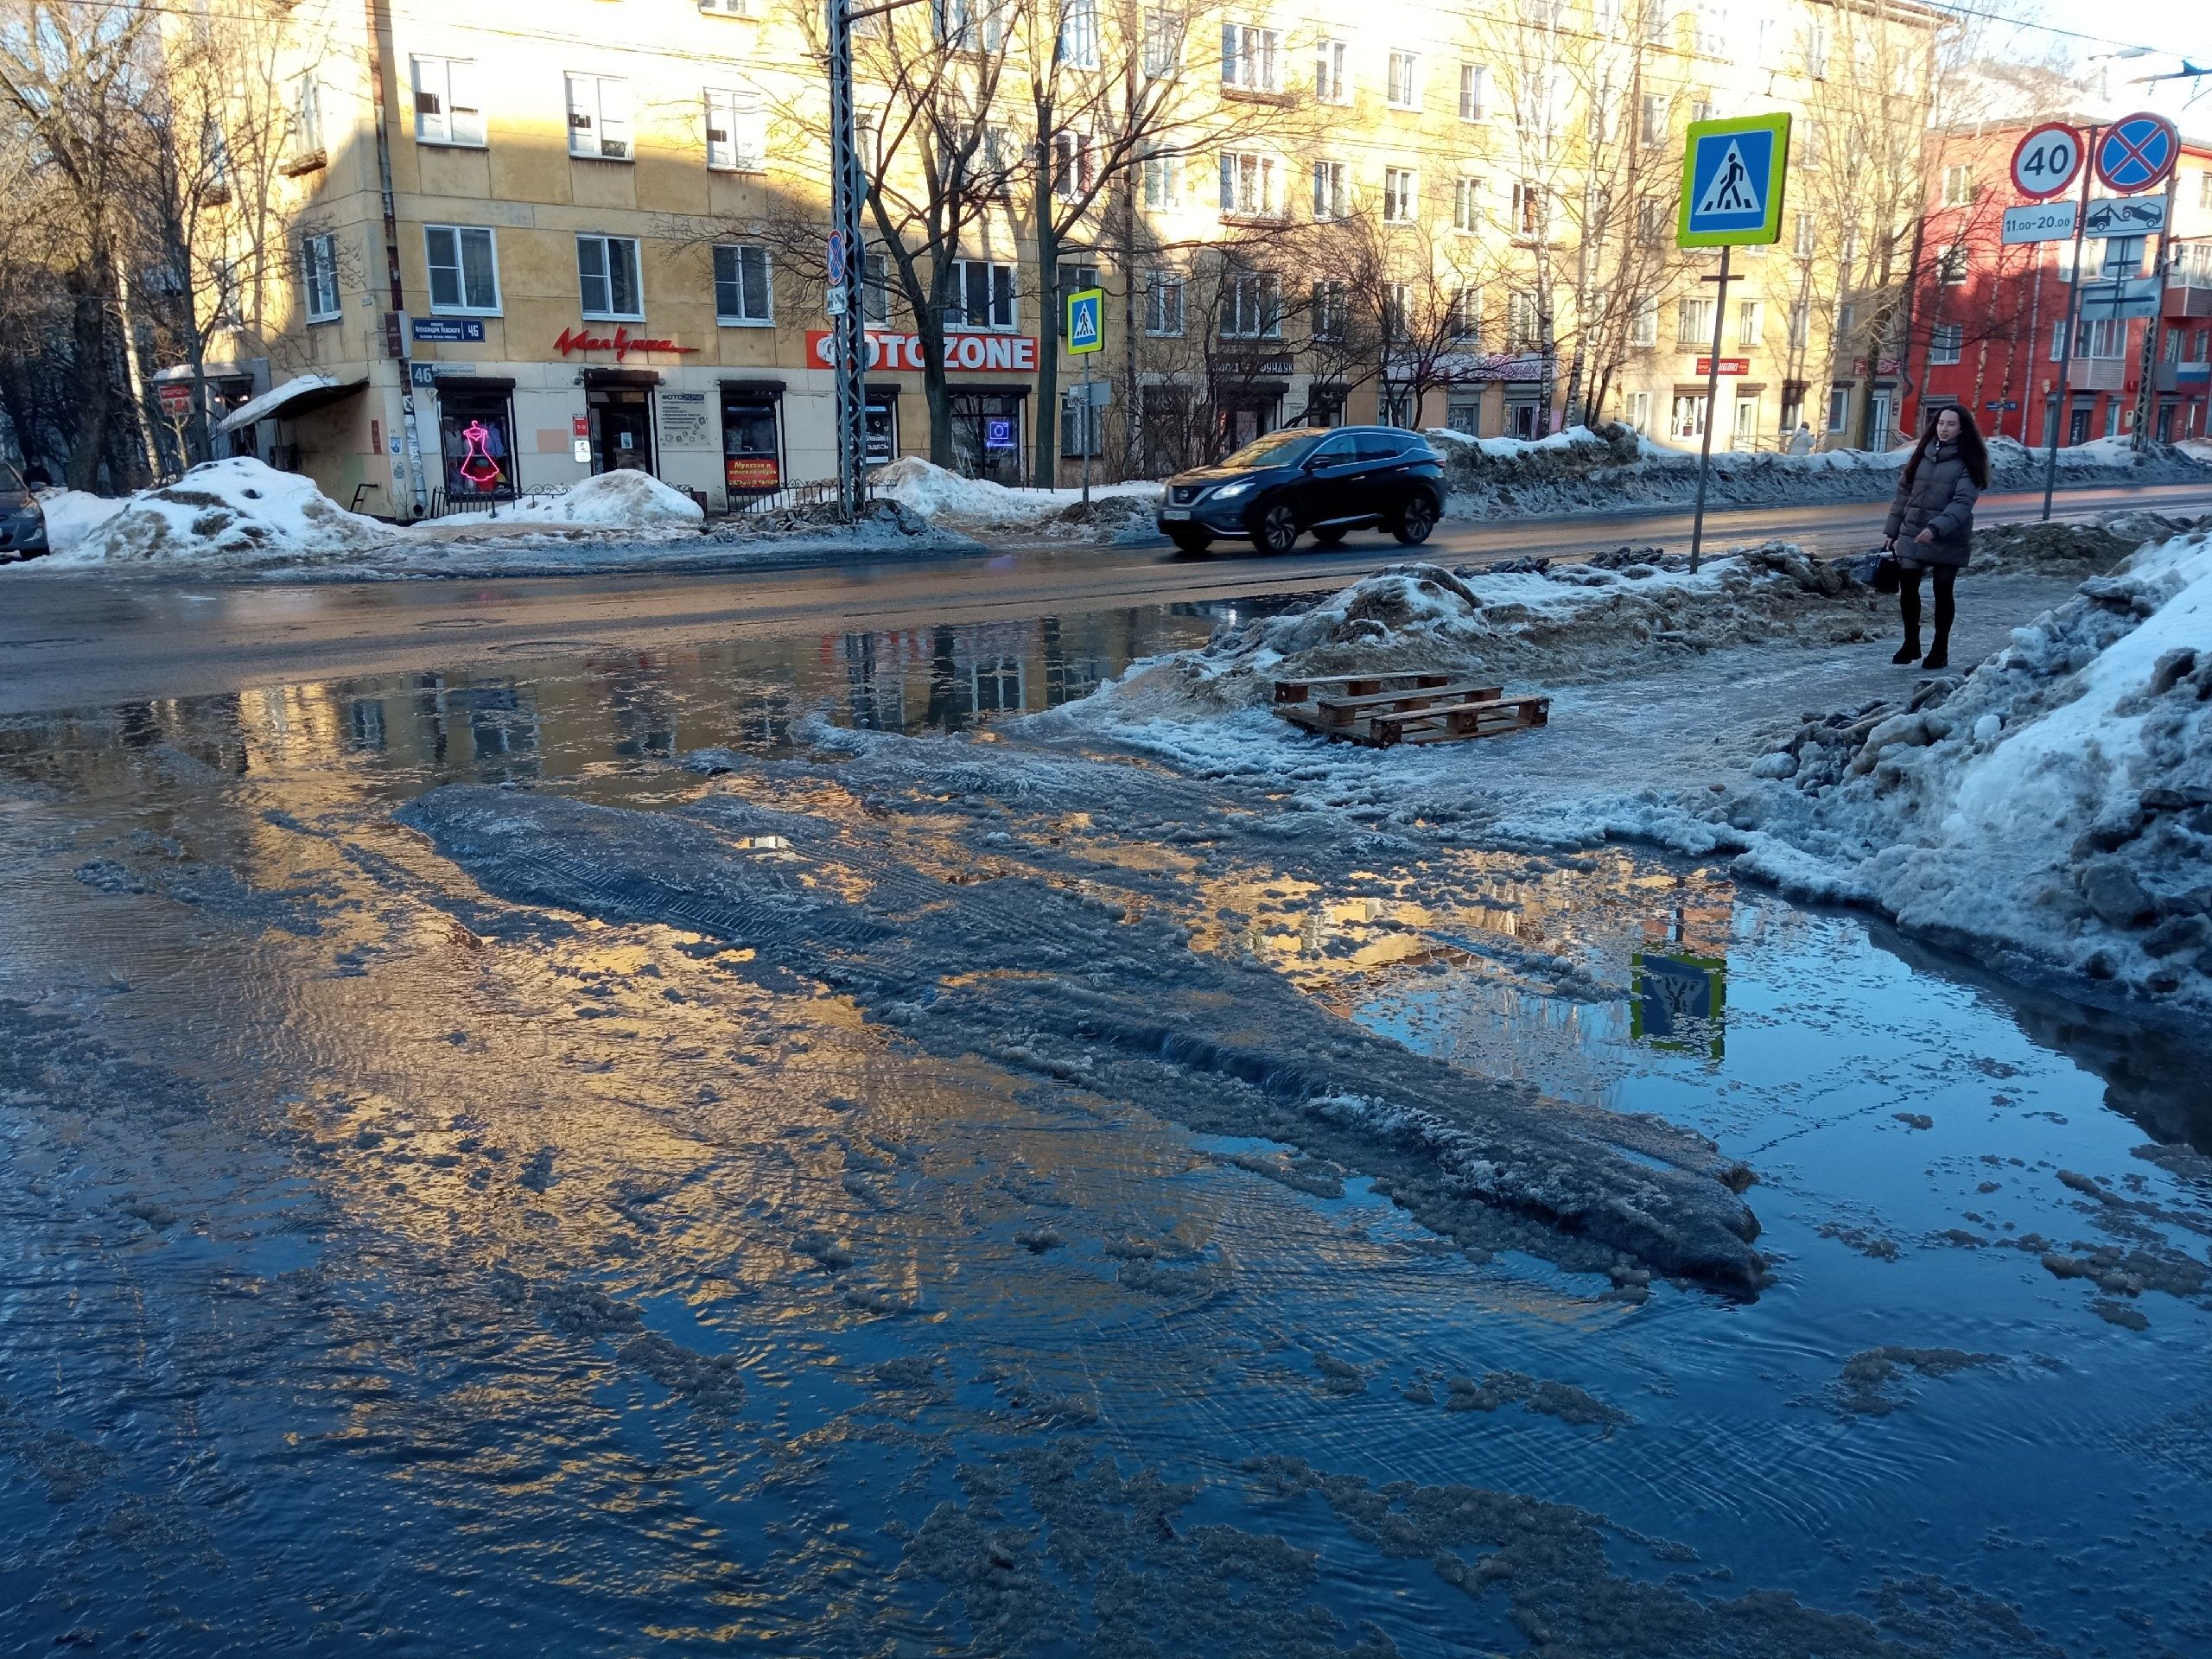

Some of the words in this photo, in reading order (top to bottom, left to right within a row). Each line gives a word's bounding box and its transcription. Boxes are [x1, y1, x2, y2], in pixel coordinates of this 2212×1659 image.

[2024, 144, 2069, 176] 40
[2005, 215, 2071, 232] 11.00-20.00
[467, 324, 480, 337] 46
[415, 367, 433, 383] 46
[734, 461, 765, 470] Мужская
